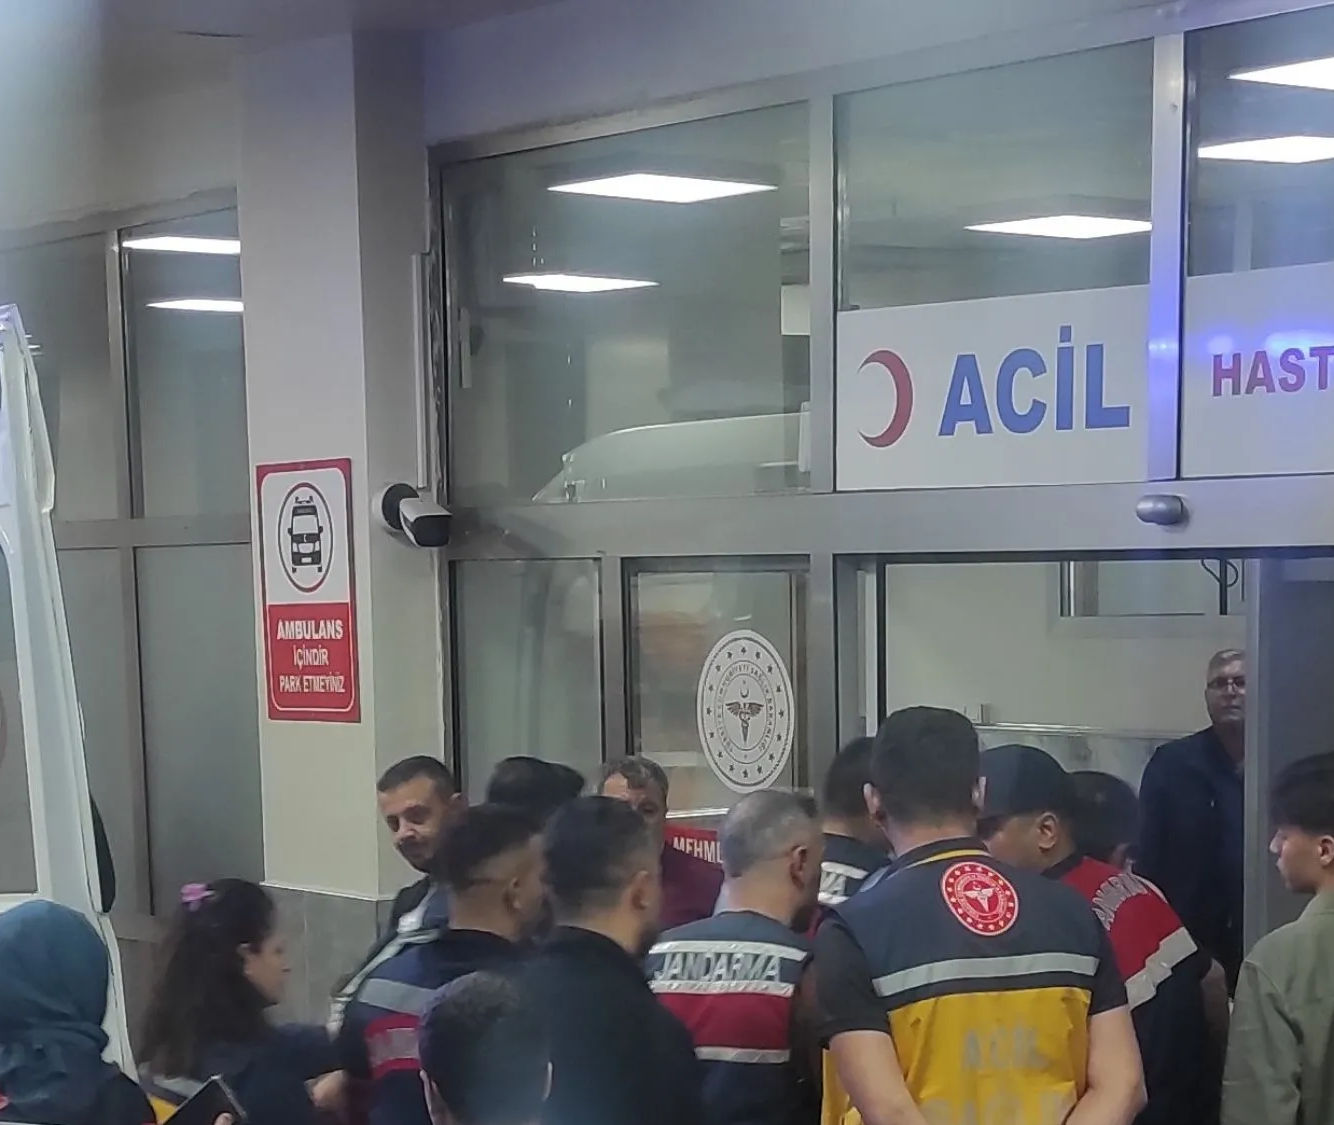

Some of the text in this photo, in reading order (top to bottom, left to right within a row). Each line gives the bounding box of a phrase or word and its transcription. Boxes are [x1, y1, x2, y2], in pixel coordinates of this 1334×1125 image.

[938, 324, 1131, 437] ACİL
[276, 618, 344, 640] AMBULANS
[279, 674, 301, 693] PARK
[653, 952, 782, 982] JANDARMA
